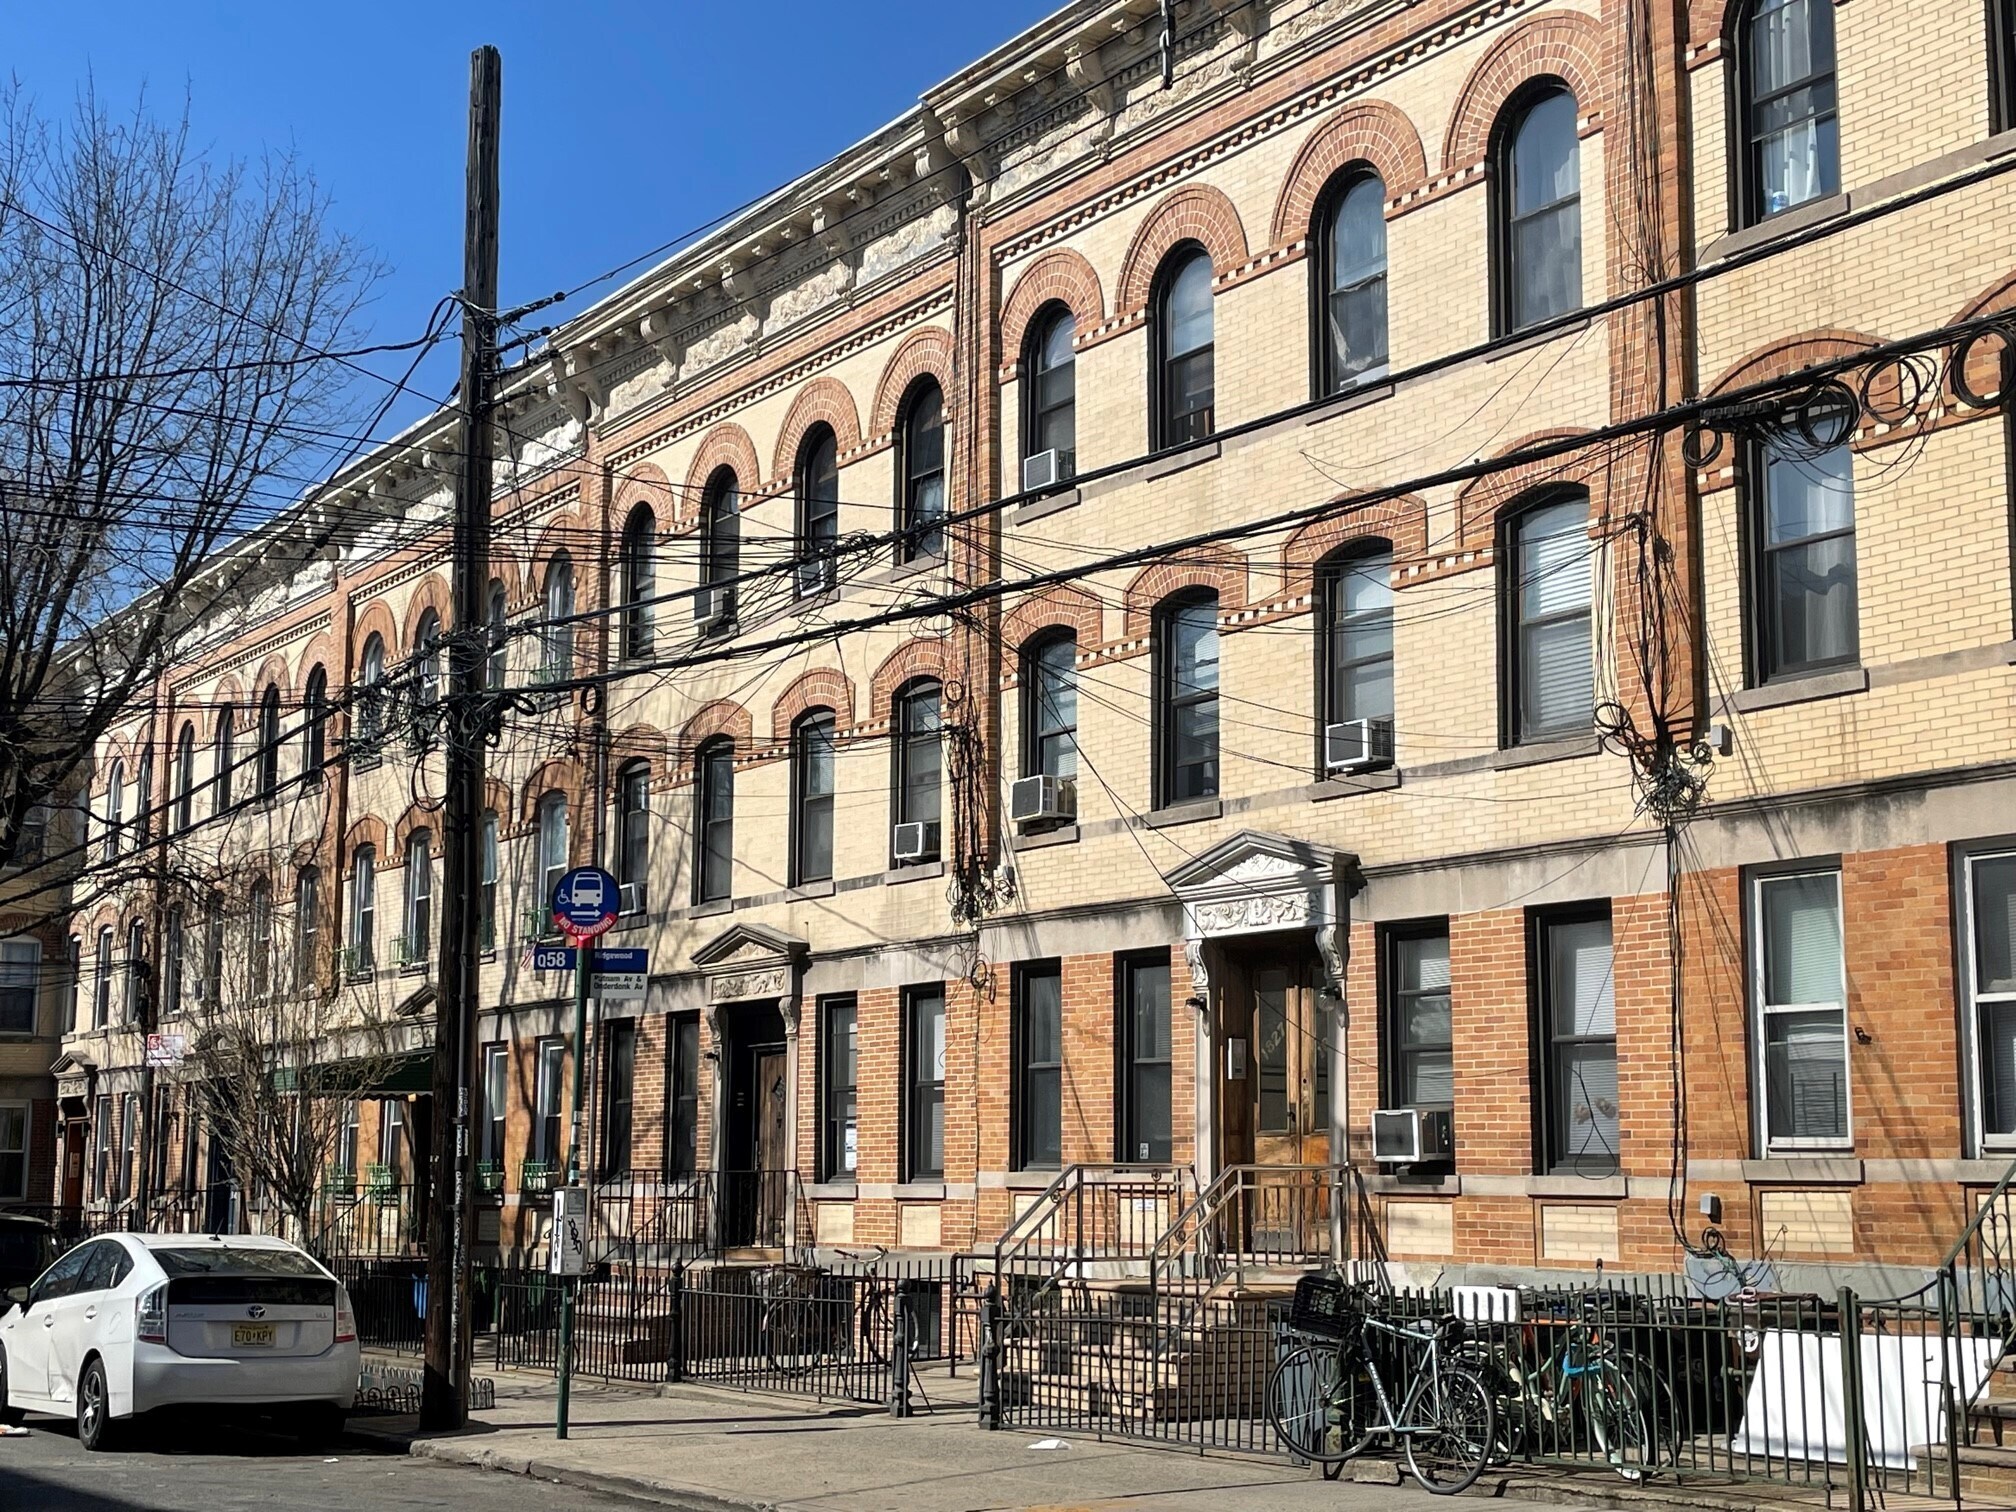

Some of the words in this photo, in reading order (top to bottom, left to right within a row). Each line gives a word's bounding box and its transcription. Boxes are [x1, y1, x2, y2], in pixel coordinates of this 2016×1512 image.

[559, 917, 571, 929] NO
[572, 917, 613, 934] STANDING
[537, 952, 566, 968] Q58
[595, 952, 633, 960] Ridgewood
